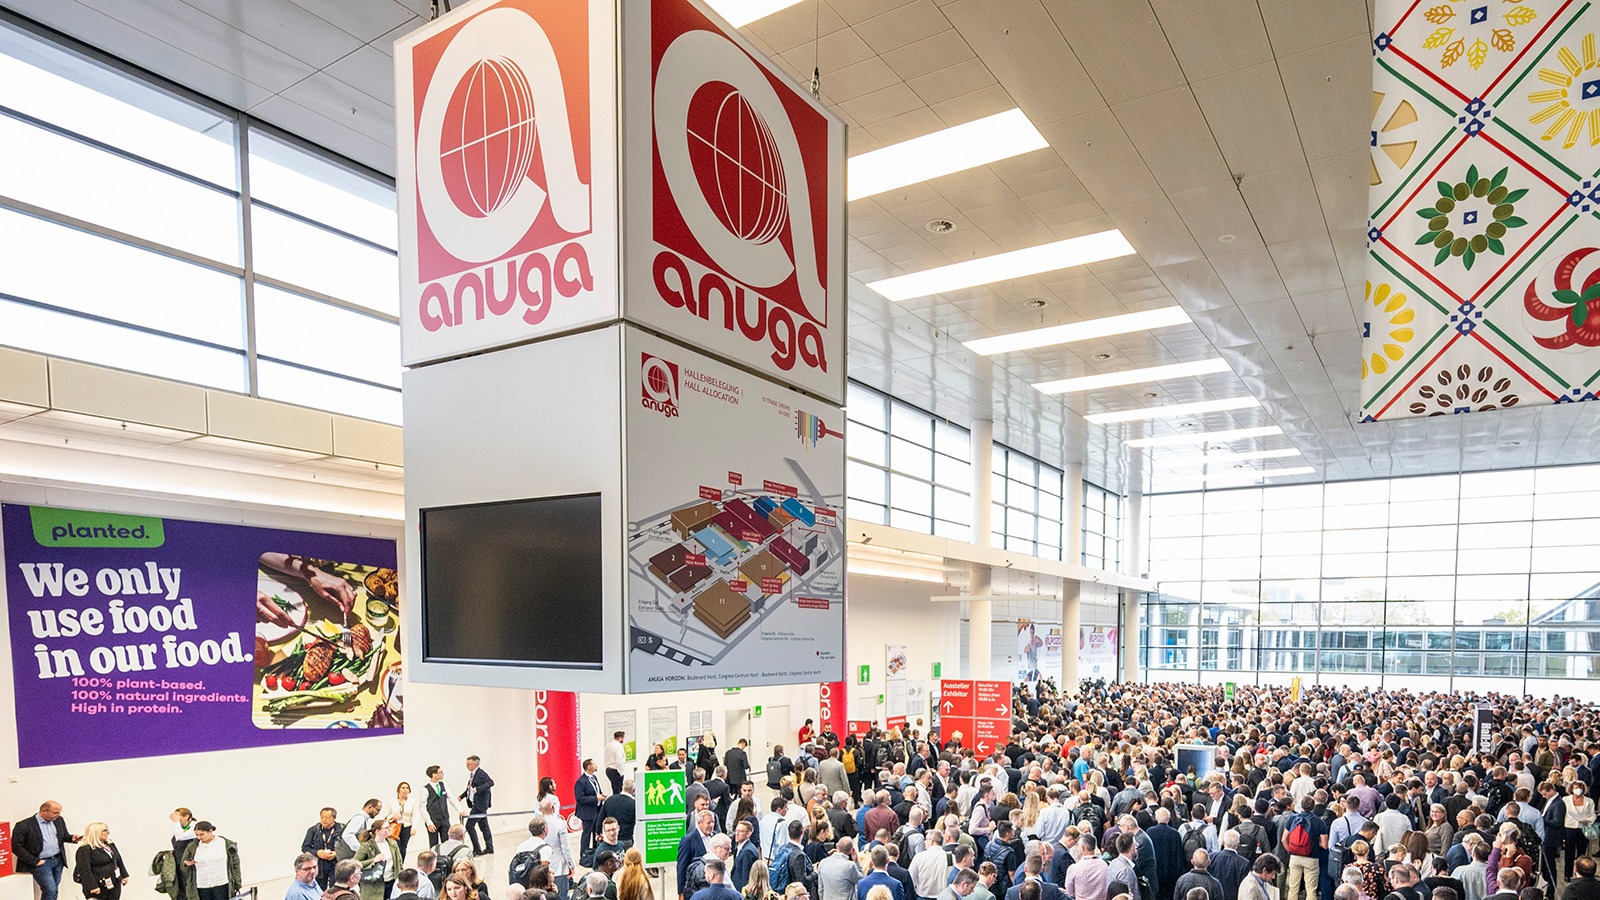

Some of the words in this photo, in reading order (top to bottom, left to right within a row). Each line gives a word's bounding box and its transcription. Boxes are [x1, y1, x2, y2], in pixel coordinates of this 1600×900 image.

[418, 242, 594, 332] anuga
[652, 251, 828, 374] anuga
[684, 368, 740, 394] HALLENBELEGUNG
[684, 380, 700, 392] HALL
[702, 387, 739, 405] ALLOCATION
[642, 398, 679, 418] anuga
[52, 523, 150, 540] planted.
[18, 563, 90, 597] We
[96, 562, 181, 600] only
[27, 608, 104, 638] use
[108, 598, 198, 634] food
[34, 644, 85, 679] in
[90, 643, 157, 674] our
[162, 632, 253, 668] food.
[71, 678, 112, 688] 100%
[116, 679, 206, 690] plant-based.
[71, 690, 112, 701] 100%
[116, 692, 169, 701] natural
[172, 692, 249, 703] ingredients.
[71, 704, 107, 714] High
[111, 704, 124, 713] in
[128, 704, 183, 714] protein.
[820, 682, 831, 720] ore
